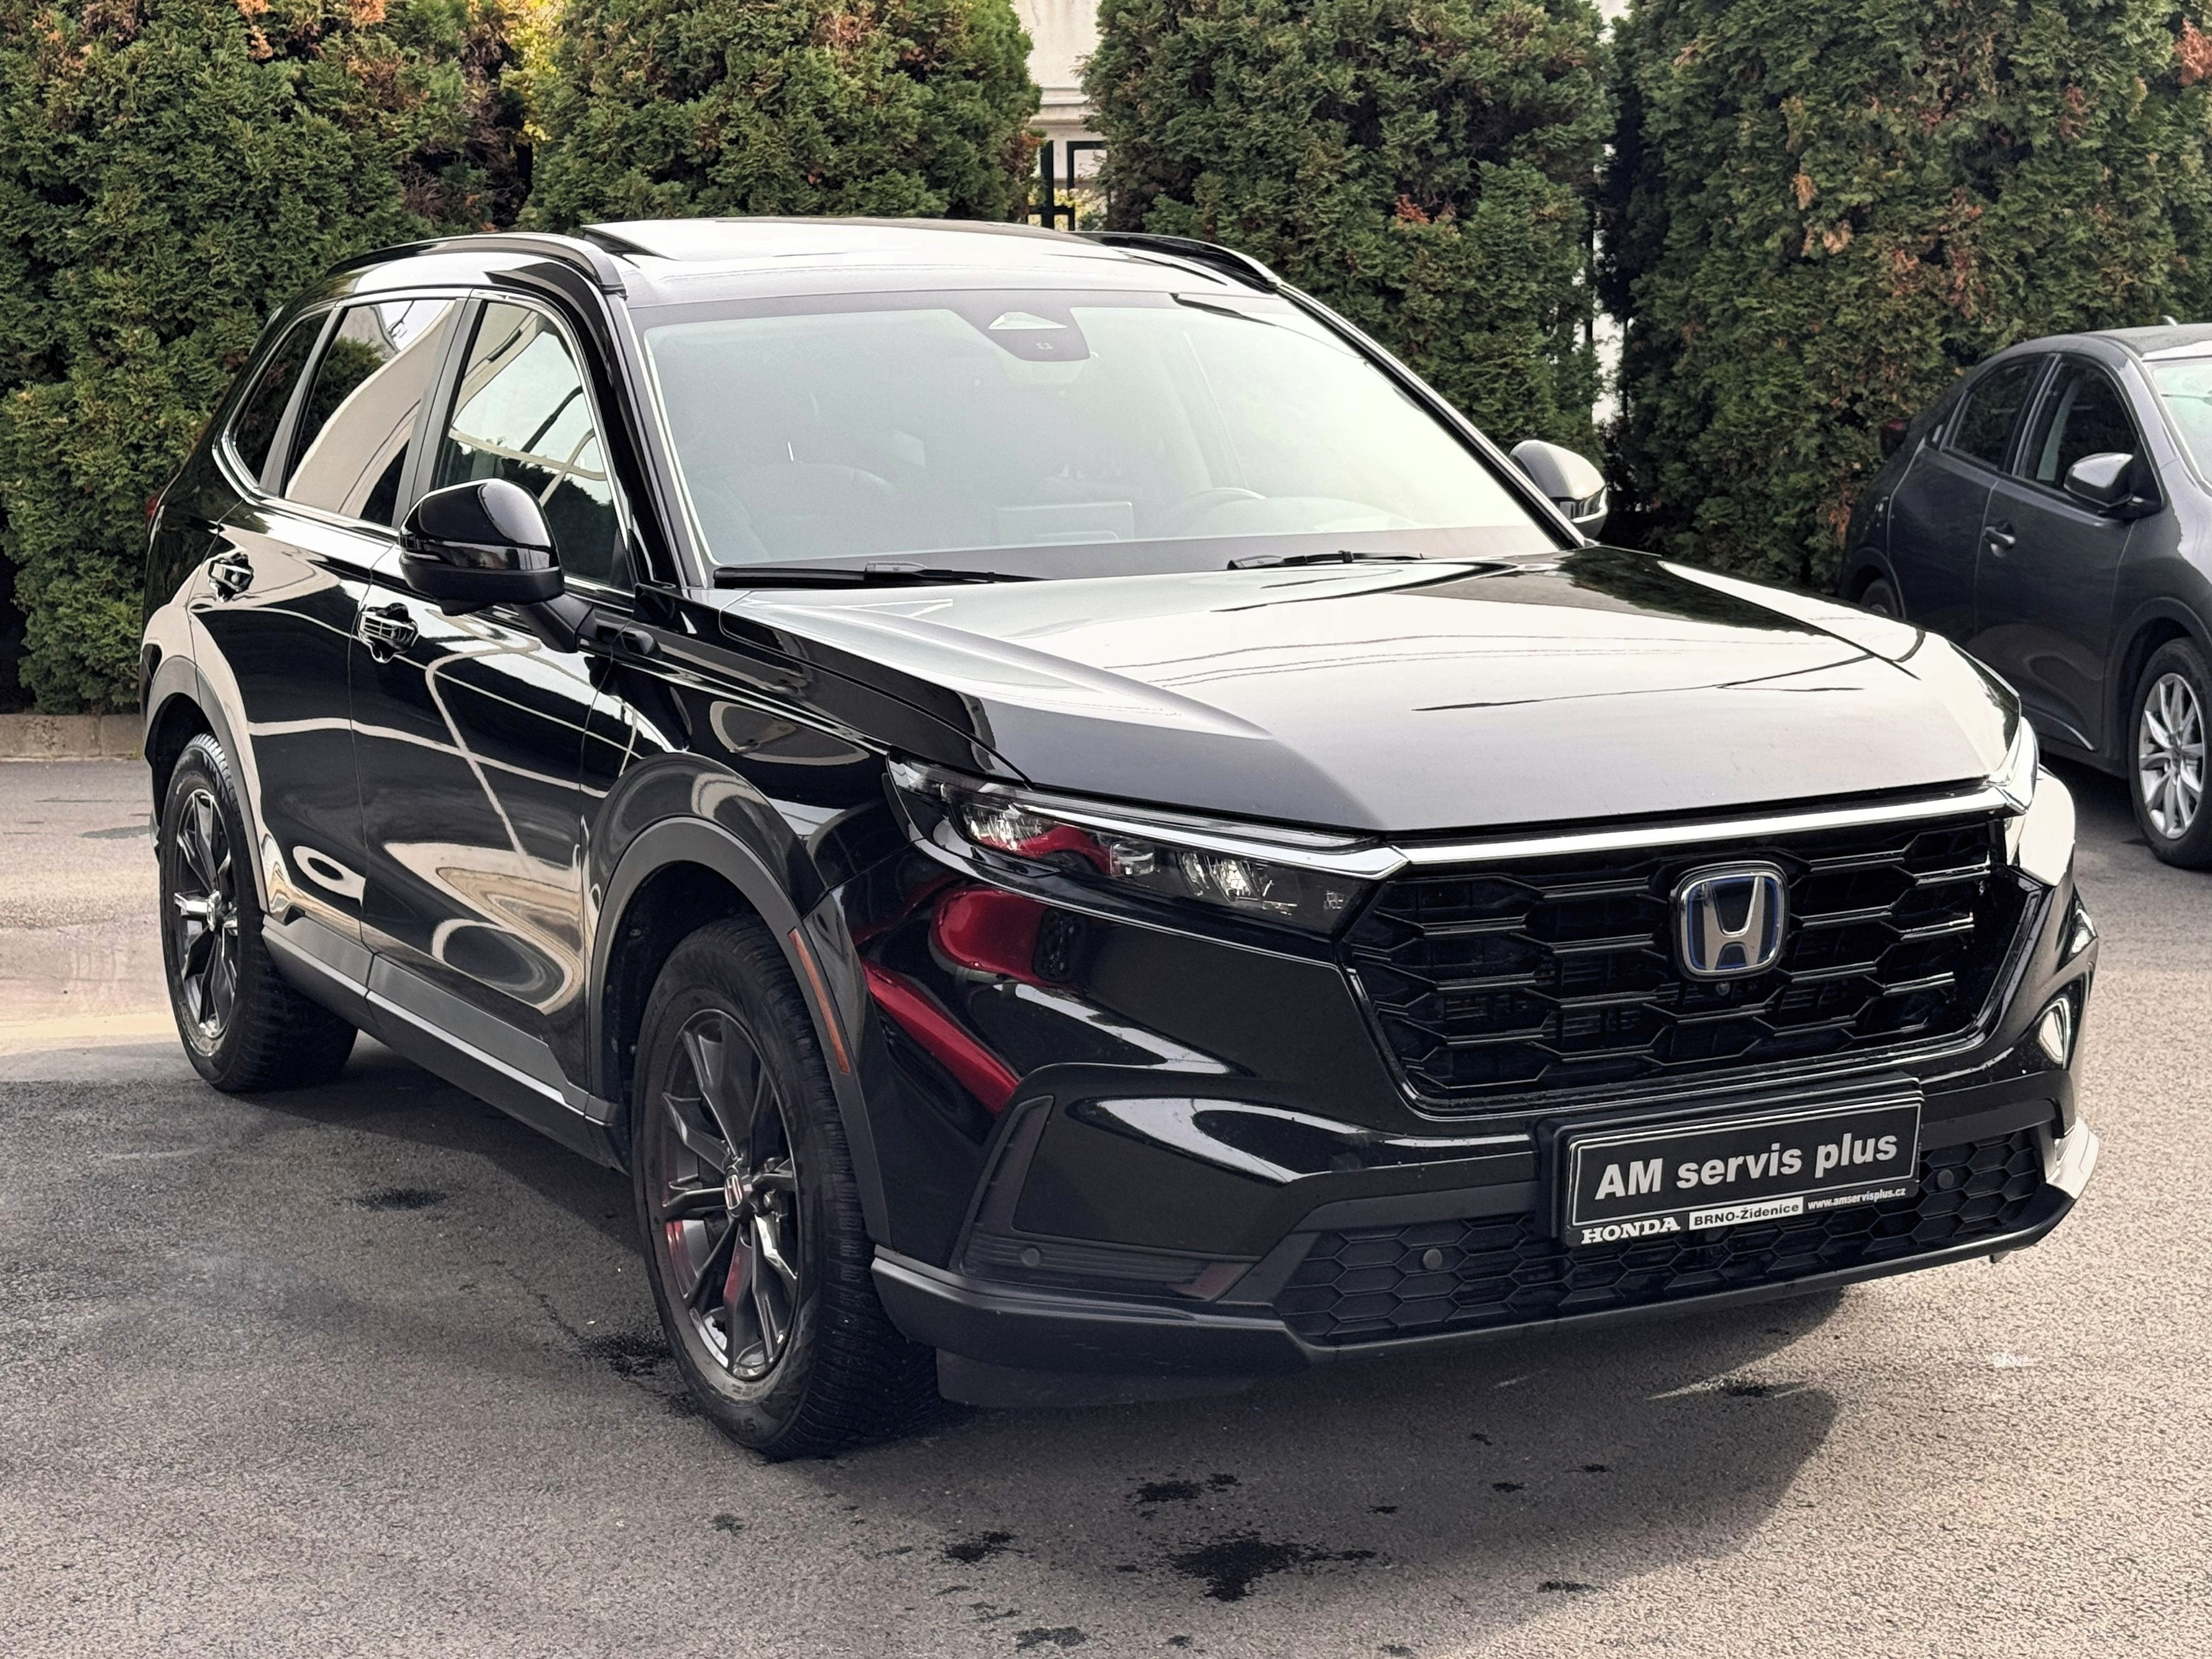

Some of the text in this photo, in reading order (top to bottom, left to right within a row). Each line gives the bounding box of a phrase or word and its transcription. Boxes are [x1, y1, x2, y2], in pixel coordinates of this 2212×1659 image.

[1595, 1133, 1897, 1200] AM servis plus
[1581, 1188, 1906, 1245] HONDA BRNO-Židenice www.amservisplus.cz
